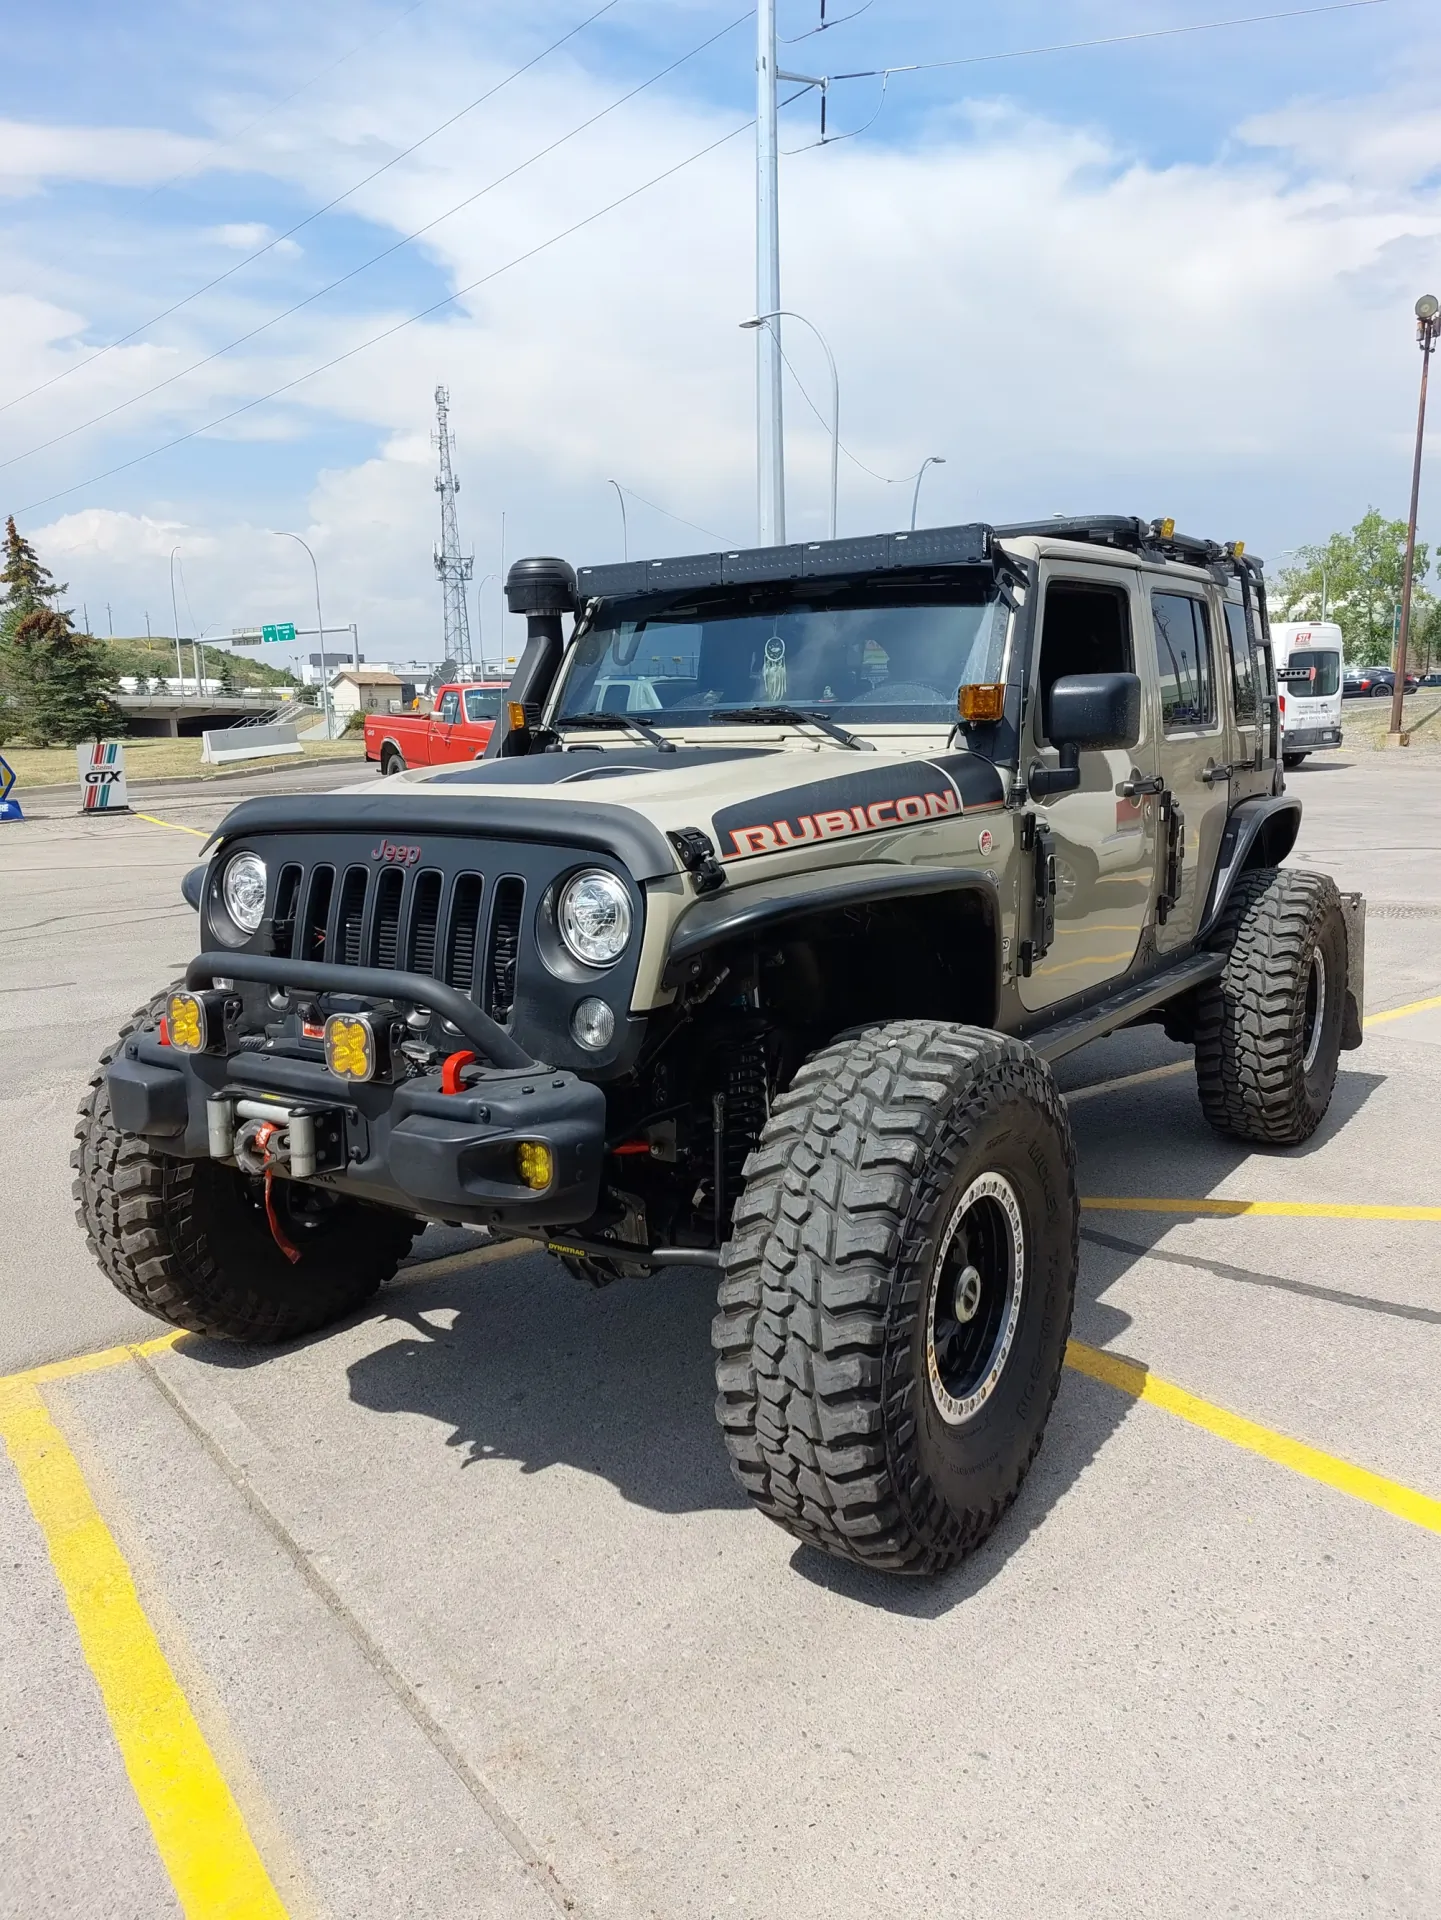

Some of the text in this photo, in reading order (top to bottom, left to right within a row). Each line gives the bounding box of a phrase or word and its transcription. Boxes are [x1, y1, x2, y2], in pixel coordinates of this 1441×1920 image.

[85, 771, 122, 784] GTX
[721, 790, 960, 859] RUBICON
[371, 839, 421, 868] Jeep
[549, 1243, 585, 1256] DYNATRAC
